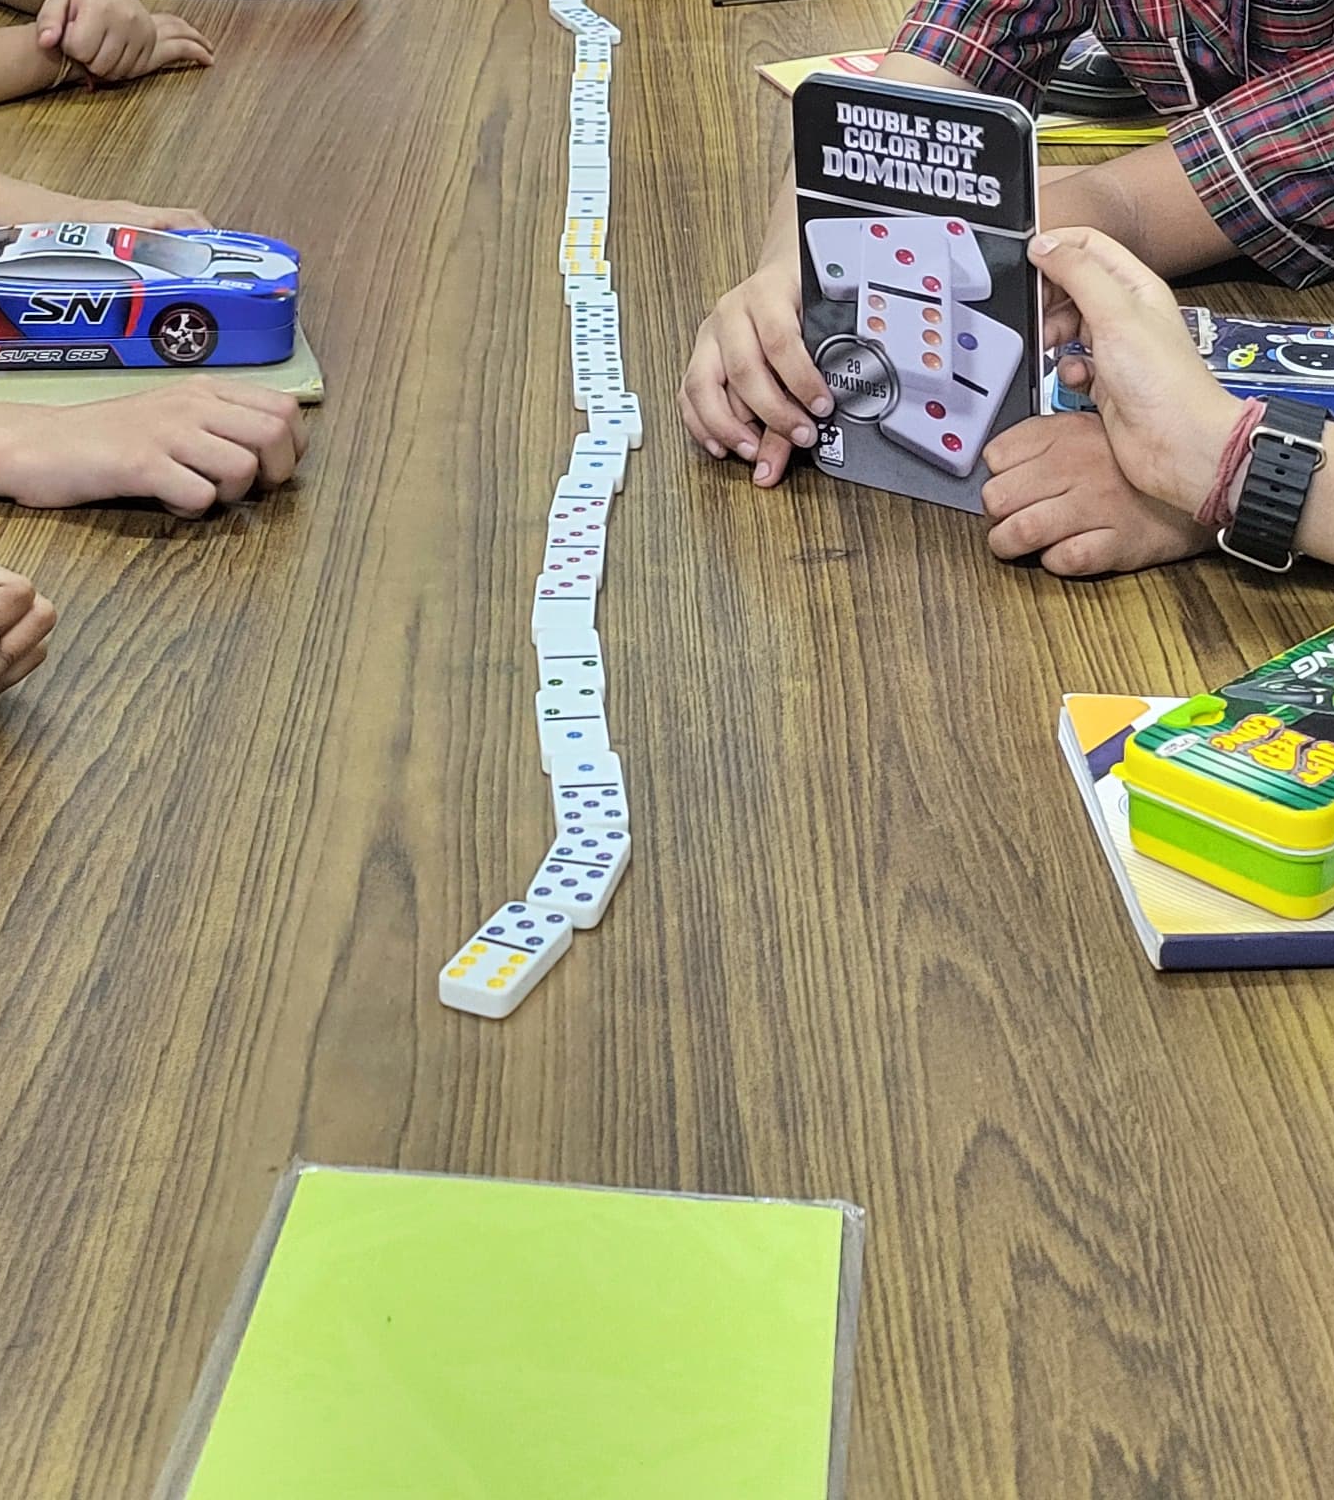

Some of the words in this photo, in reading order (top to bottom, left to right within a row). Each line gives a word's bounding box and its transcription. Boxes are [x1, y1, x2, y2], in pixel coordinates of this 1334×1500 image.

[836, 102, 932, 138] DOUBLE
[934, 118, 985, 150] SIX
[843, 125, 922, 162] COLOR
[927, 140, 978, 172] DOT
[822, 145, 1002, 208] DOMINOES
[19, 288, 115, 325] SN
[847, 358, 861, 375] 28
